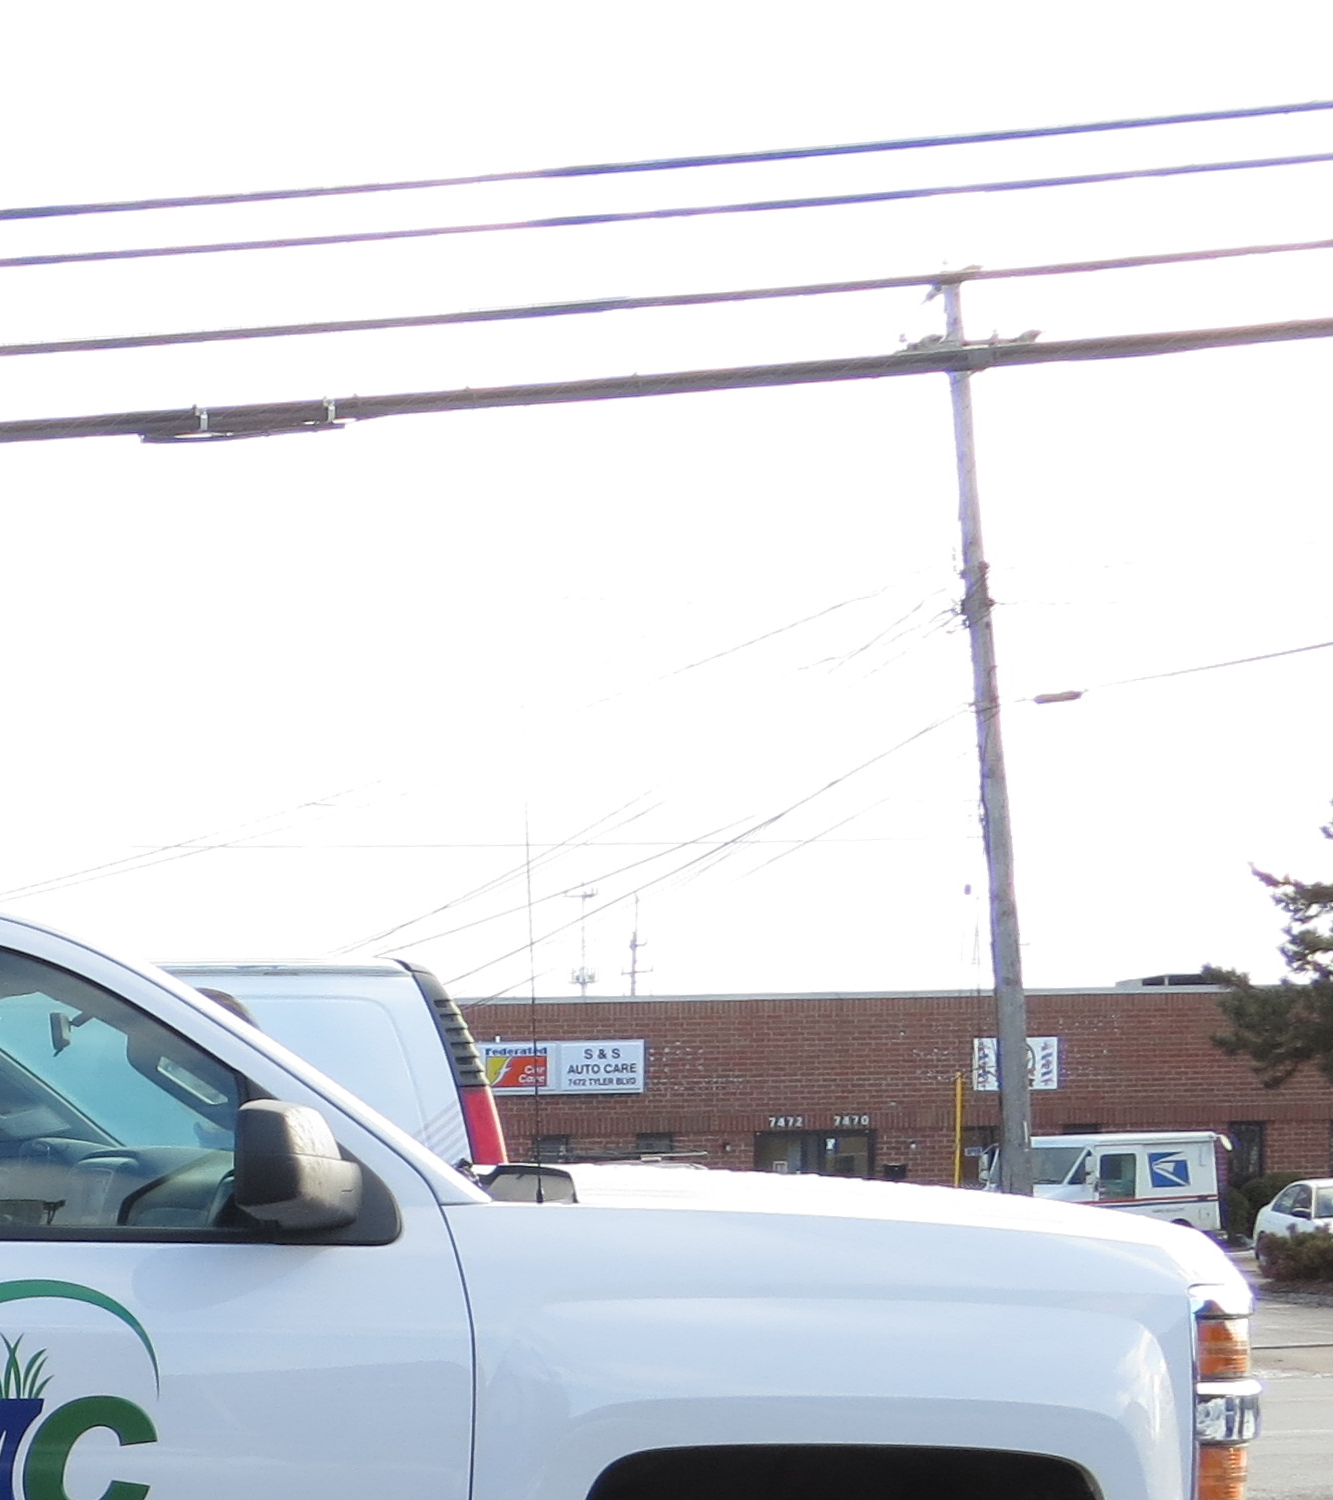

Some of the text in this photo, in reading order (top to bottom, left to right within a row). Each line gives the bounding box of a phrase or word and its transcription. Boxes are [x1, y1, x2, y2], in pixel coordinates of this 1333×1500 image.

[584, 1048, 620, 1060] S & S
[525, 1066, 545, 1074] Car
[567, 1063, 637, 1074] AUTO CARE
[588, 1078, 613, 1086] TYLER
[769, 1117, 803, 1127] 7472
[834, 1115, 870, 1126] 7470
